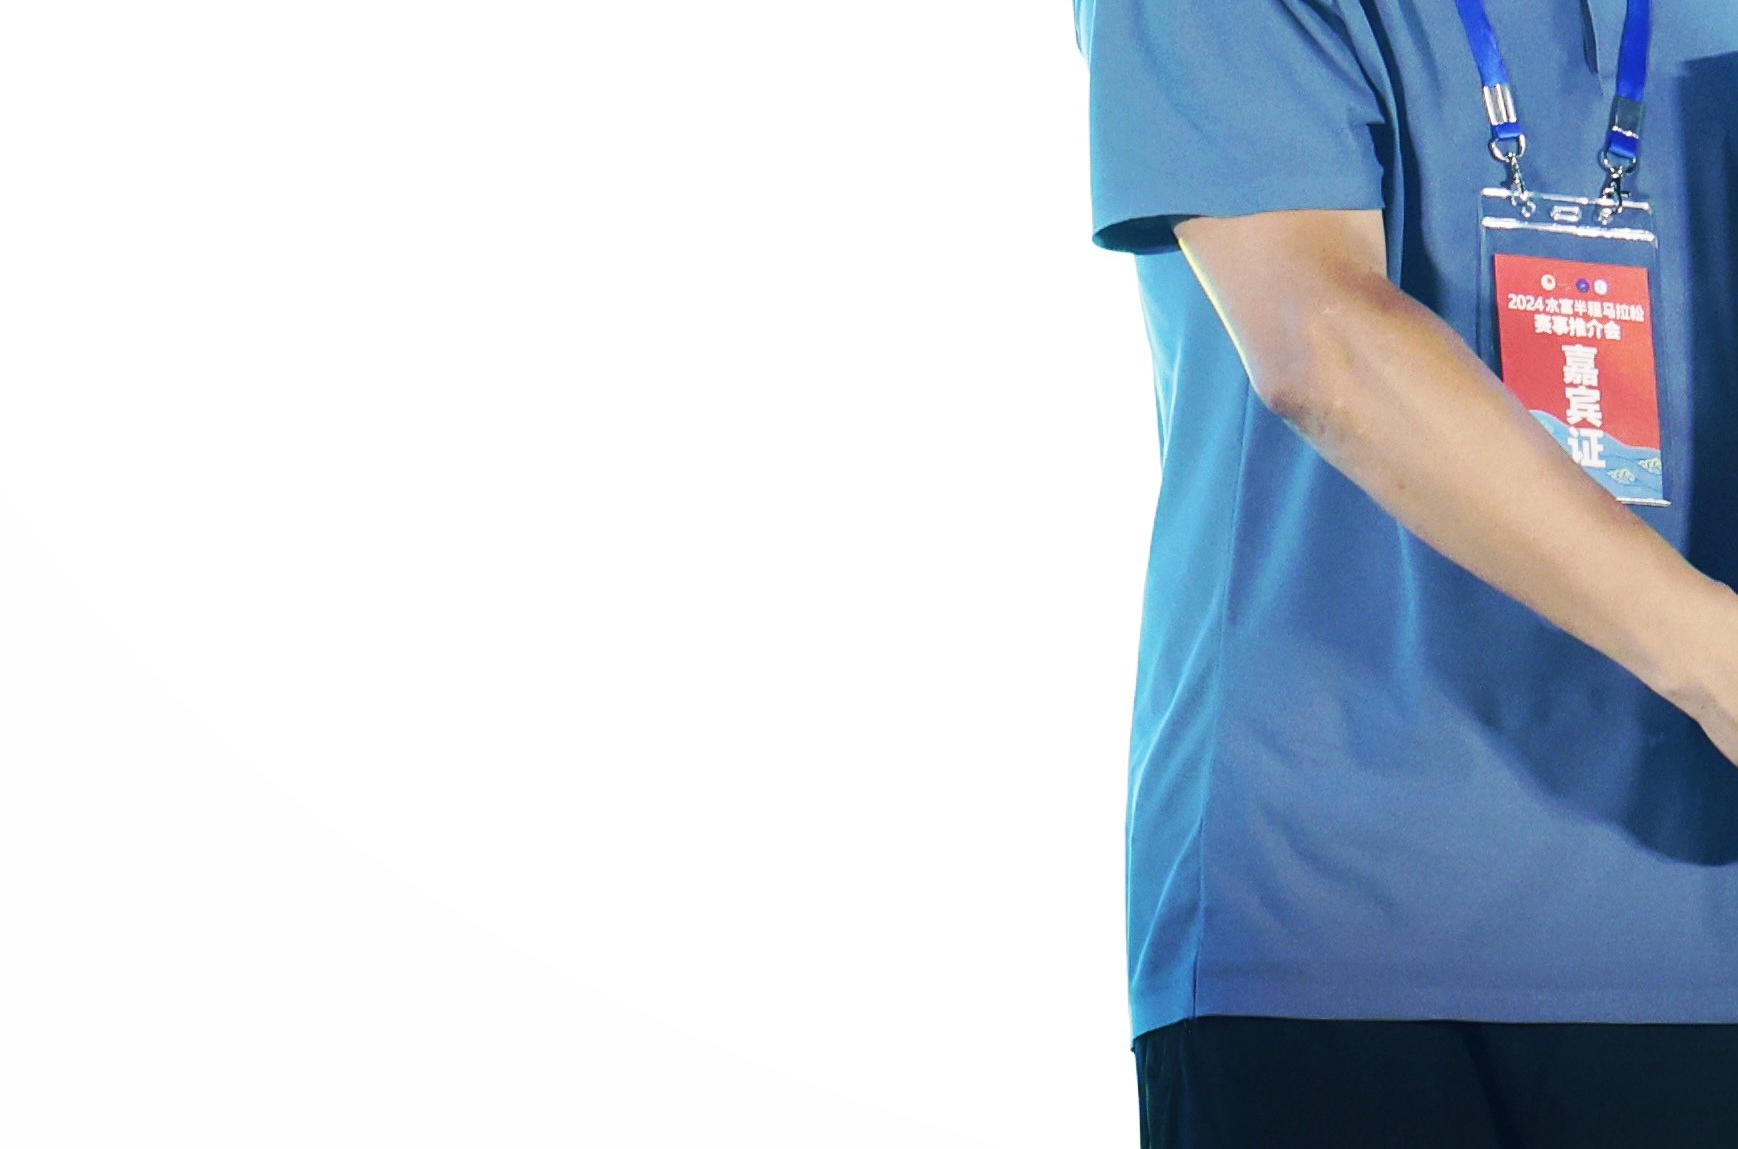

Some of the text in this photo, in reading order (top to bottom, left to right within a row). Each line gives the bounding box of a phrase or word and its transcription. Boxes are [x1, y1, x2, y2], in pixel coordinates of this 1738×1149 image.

[1507, 293, 1644, 323] 2024水富半程马拉松
[1533, 313, 1621, 341] 赛事推介会
[1561, 344, 1606, 468] 嘉宾证
